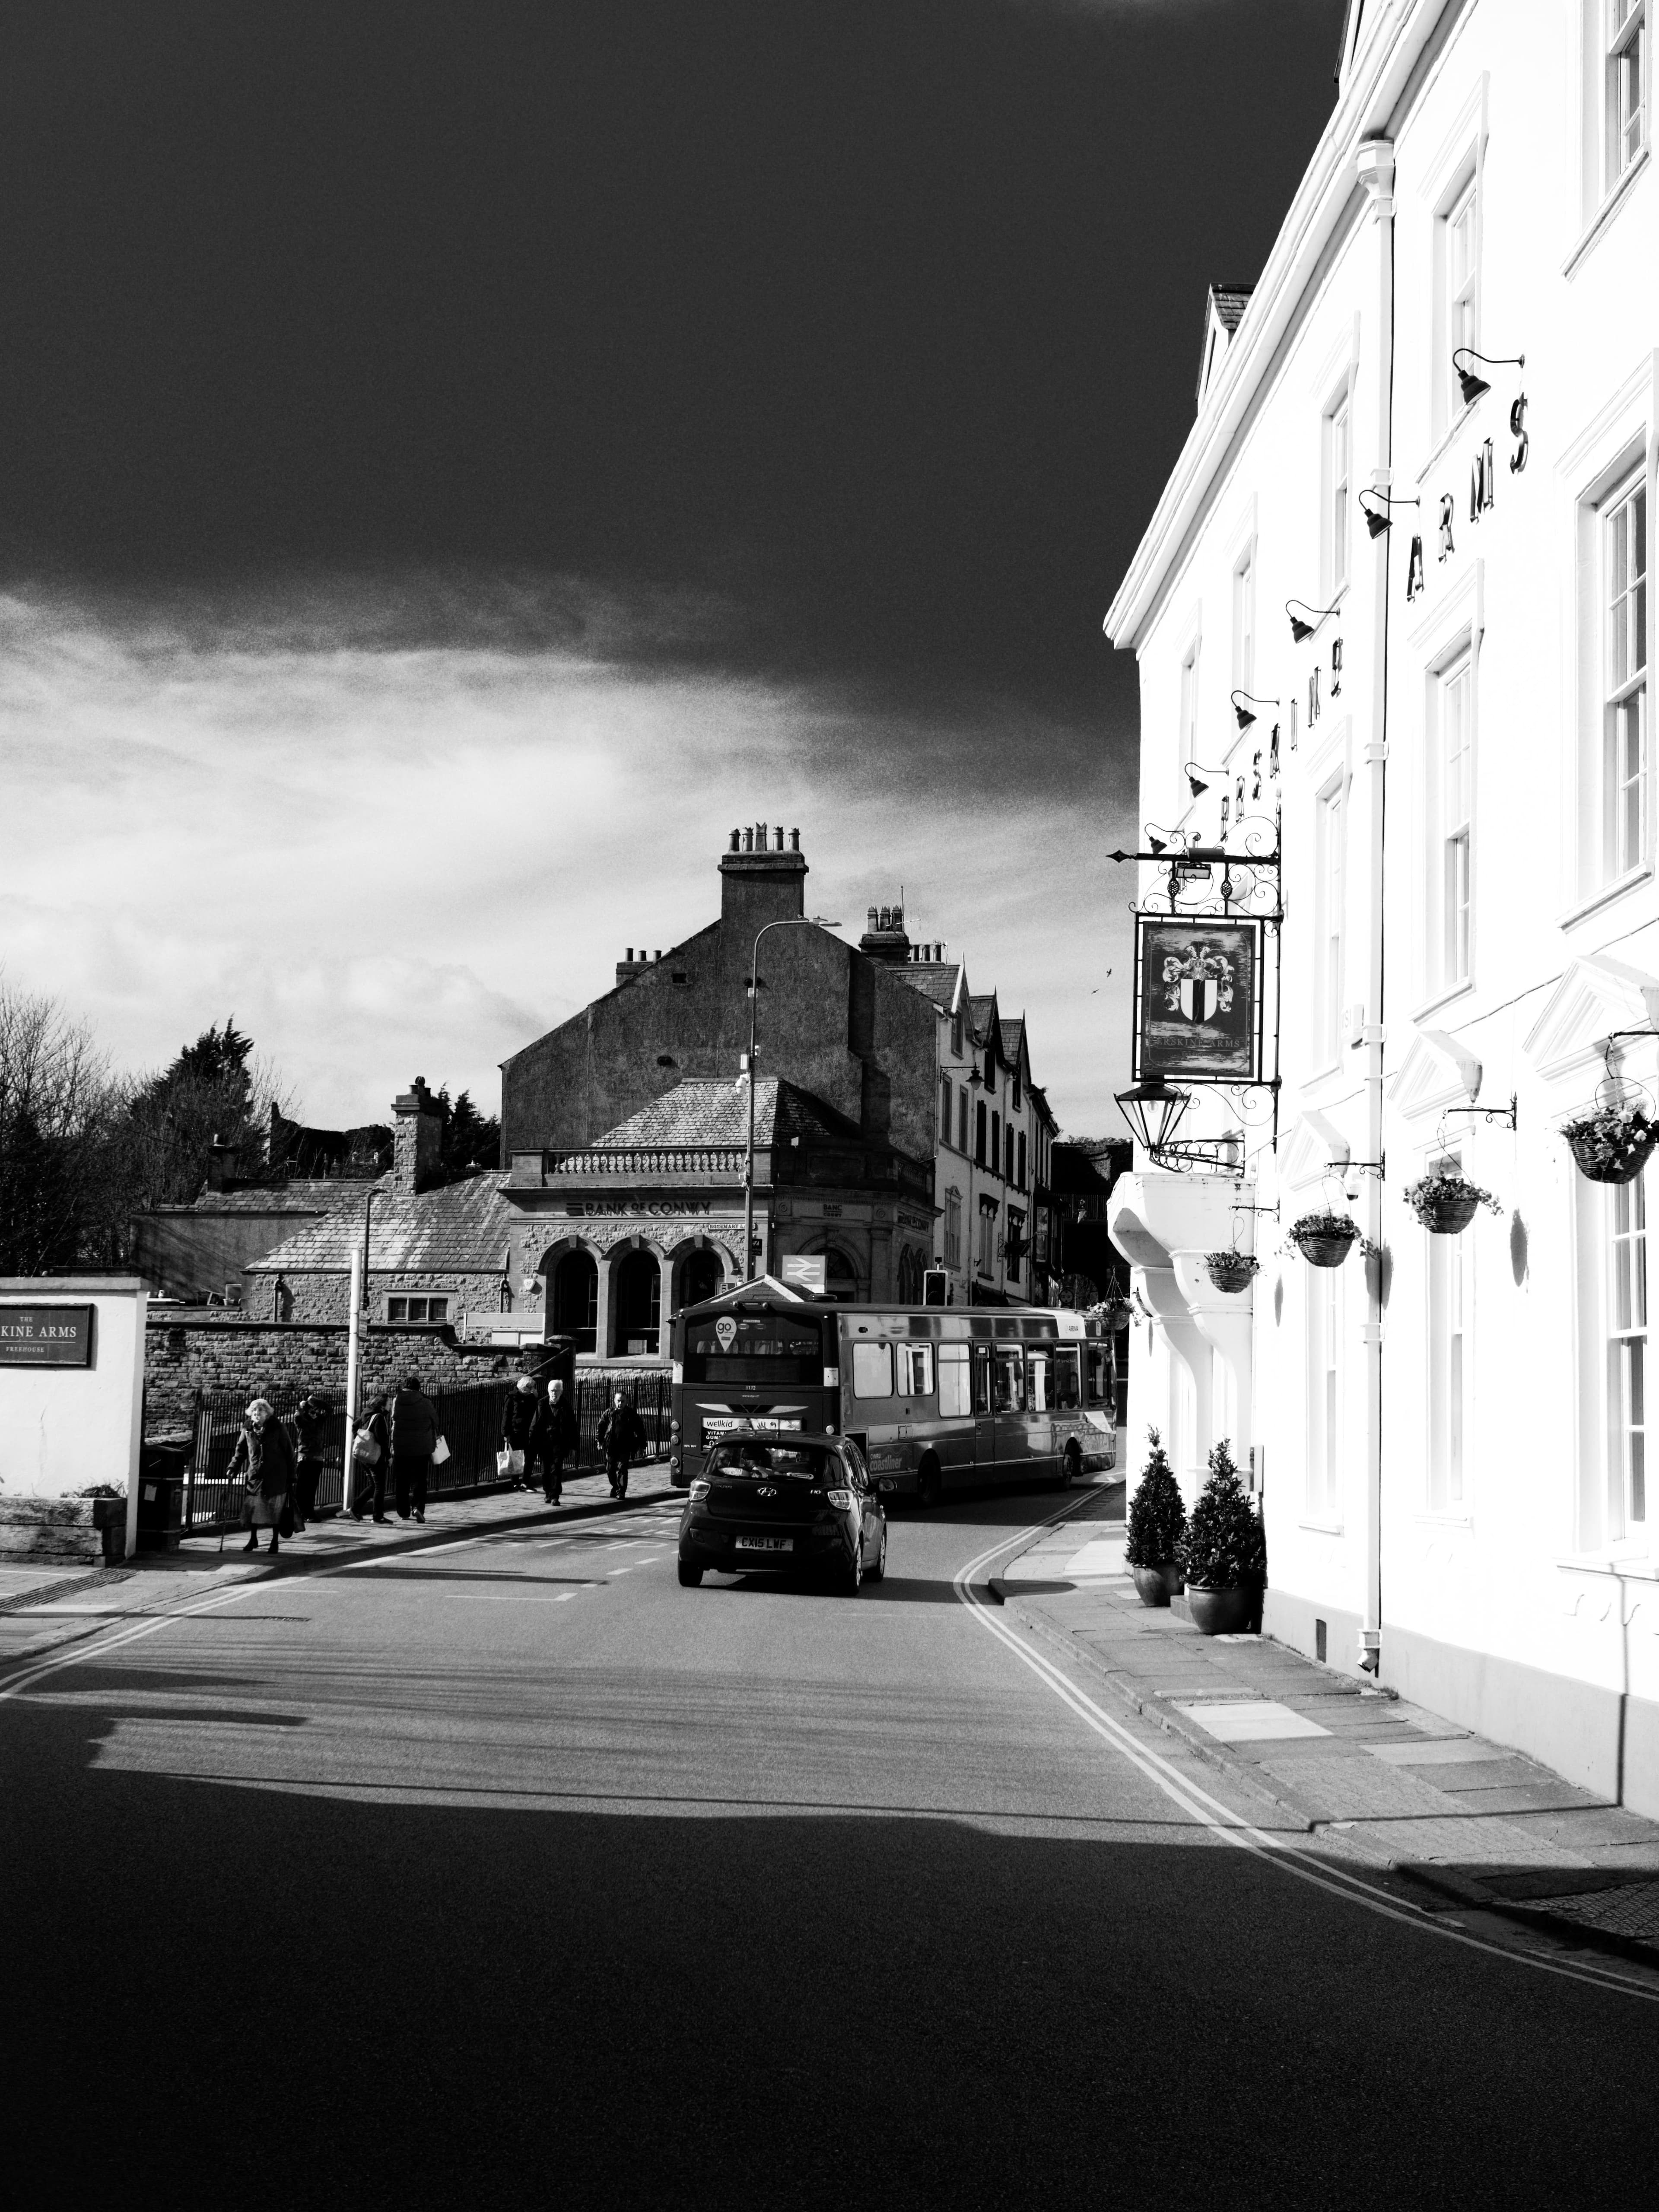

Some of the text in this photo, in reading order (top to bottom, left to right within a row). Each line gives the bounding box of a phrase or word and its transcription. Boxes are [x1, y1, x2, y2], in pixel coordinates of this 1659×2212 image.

[1220, 392, 1529, 843] ERSKINE ARMS
[1157, 1038, 1239, 1048] ERSKINE ARMS
[586, 1202, 626, 1215] BANK
[648, 1202, 710, 1215] CONWY
[38, 1326, 76, 1338] ARMS
[717, 1323, 731, 1334] go
[870, 1455, 903, 1471] coastliner
[742, 1537, 764, 1548] CX15
